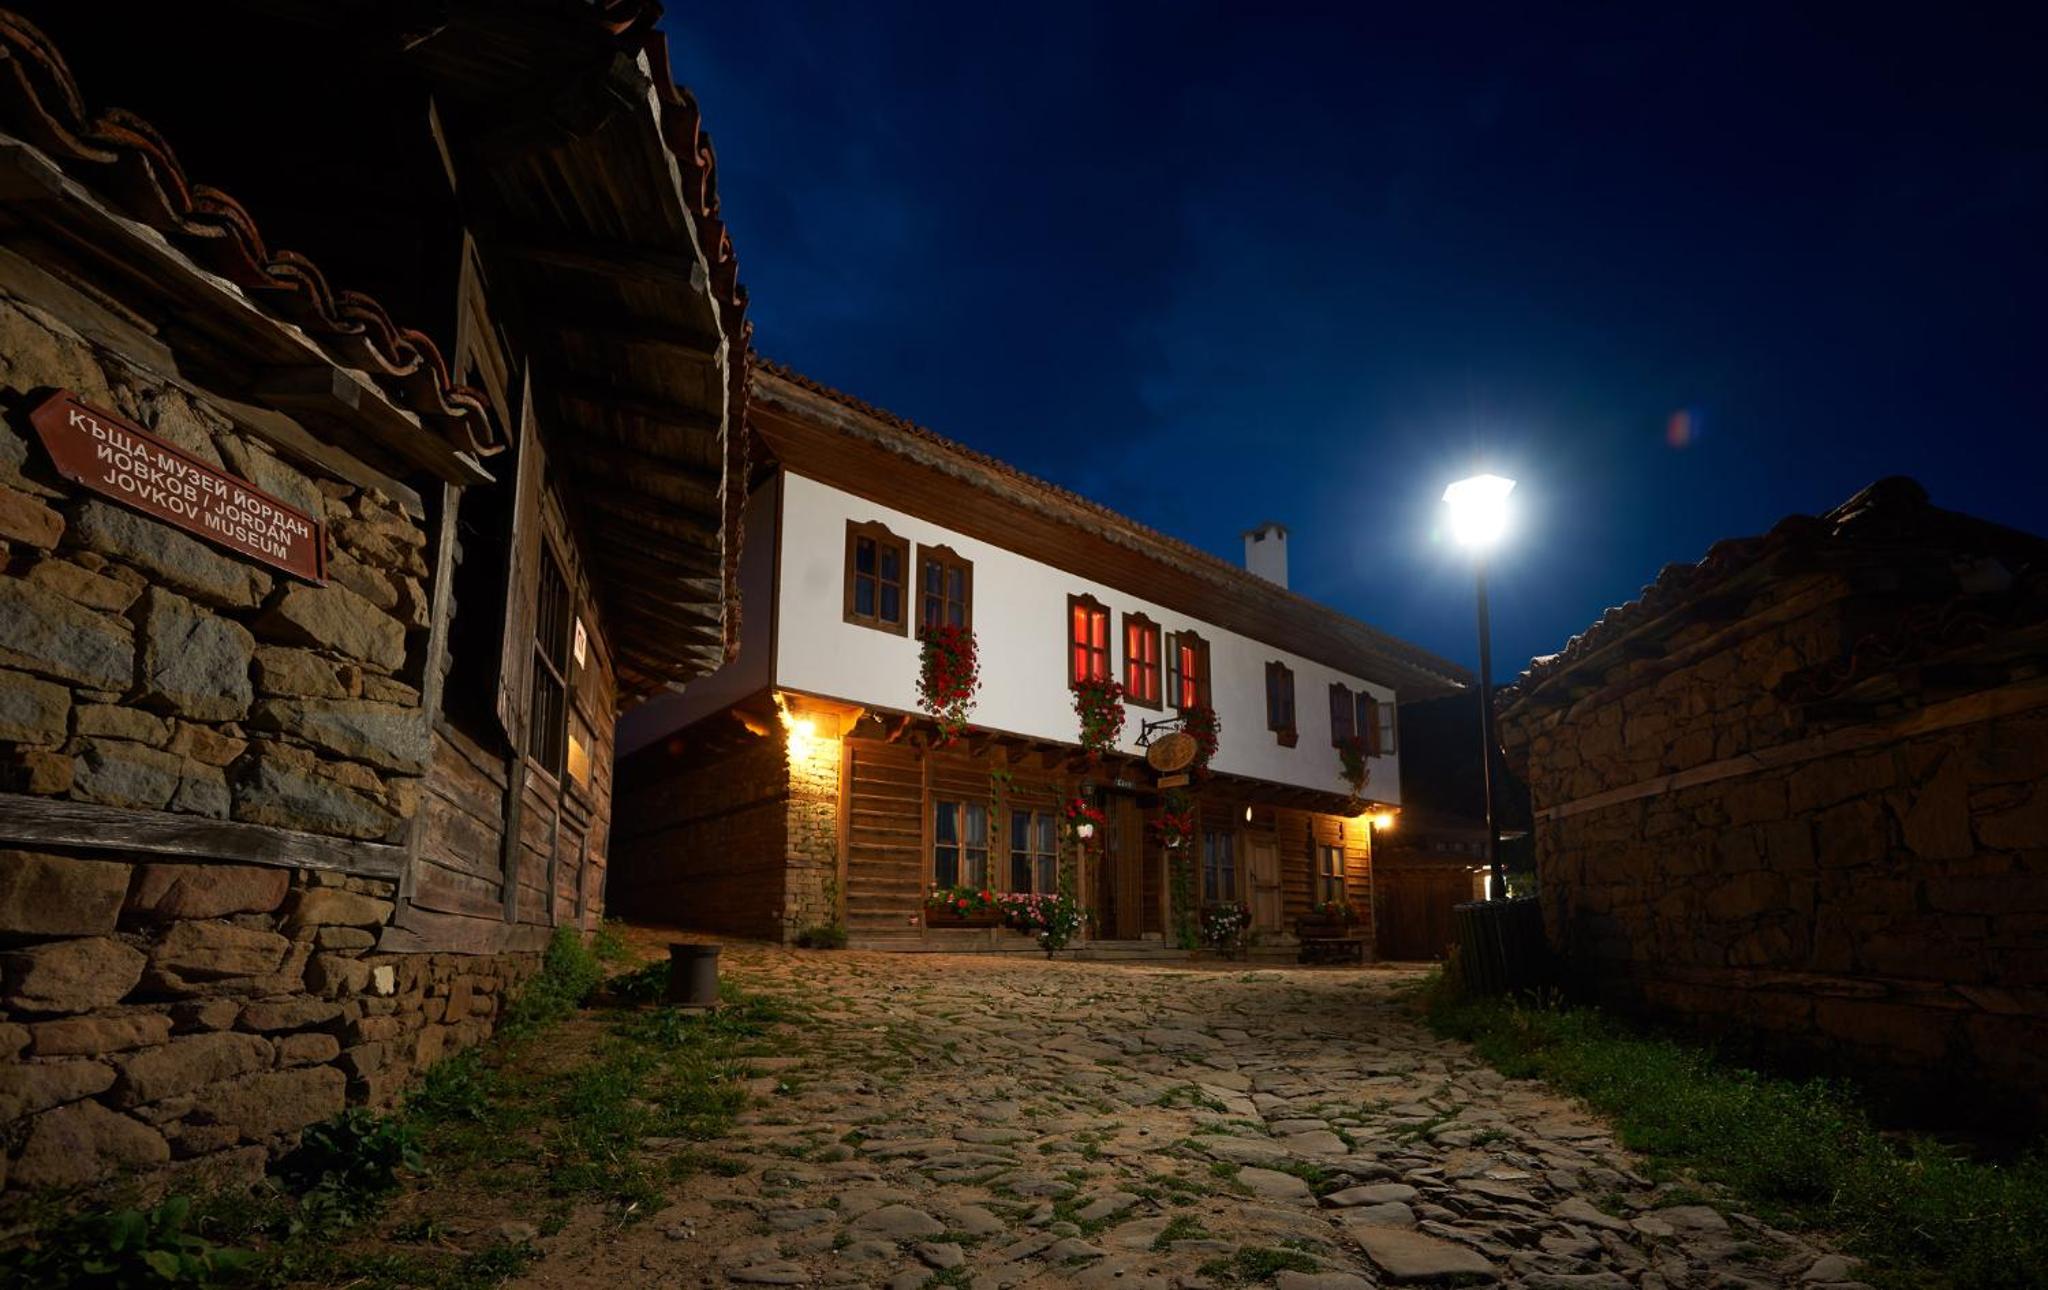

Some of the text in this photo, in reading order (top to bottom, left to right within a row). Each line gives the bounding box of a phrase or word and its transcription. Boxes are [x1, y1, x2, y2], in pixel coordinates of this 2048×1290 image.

[69, 410, 308, 538] КЪЩА-МУЗЕЙ ЙОРДАН
[96, 444, 198, 502] ЙОВКОВ
[215, 501, 291, 546] JORDAN
[103, 469, 287, 560] JOVKOV MUSEUM
